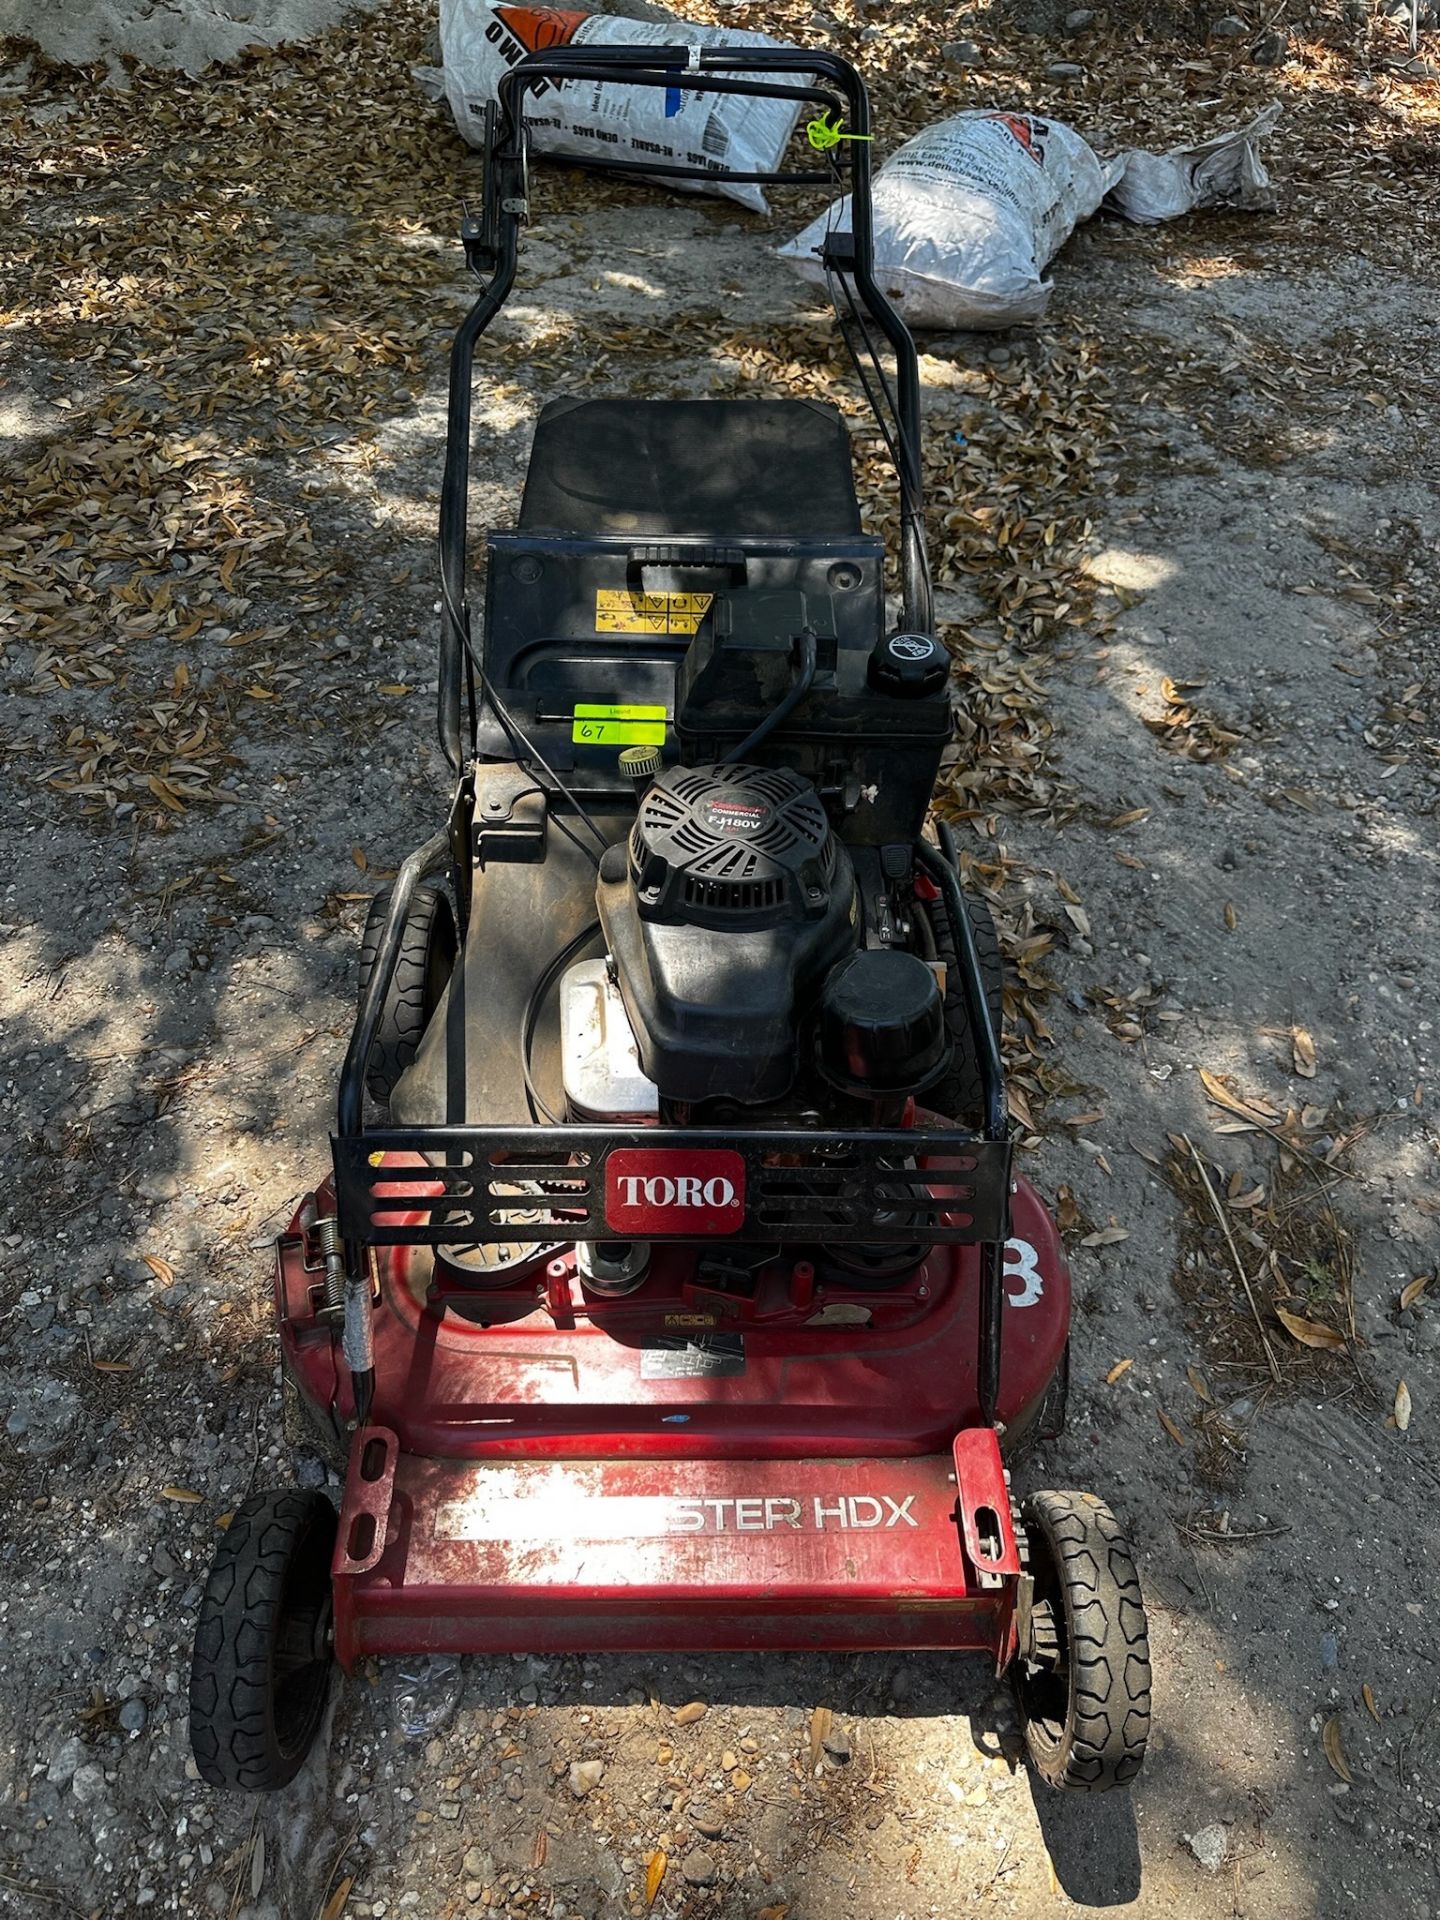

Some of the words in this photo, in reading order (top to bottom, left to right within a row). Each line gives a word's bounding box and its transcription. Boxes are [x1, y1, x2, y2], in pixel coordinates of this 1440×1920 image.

[631, 138, 673, 157] RE-USABLE
[581, 725, 605, 740] 67
[711, 807, 761, 819] COMMERCIAL
[708, 815, 761, 830] FJ180V
[617, 1176, 735, 1207] TORO
[813, 1495, 919, 1529] HDX
